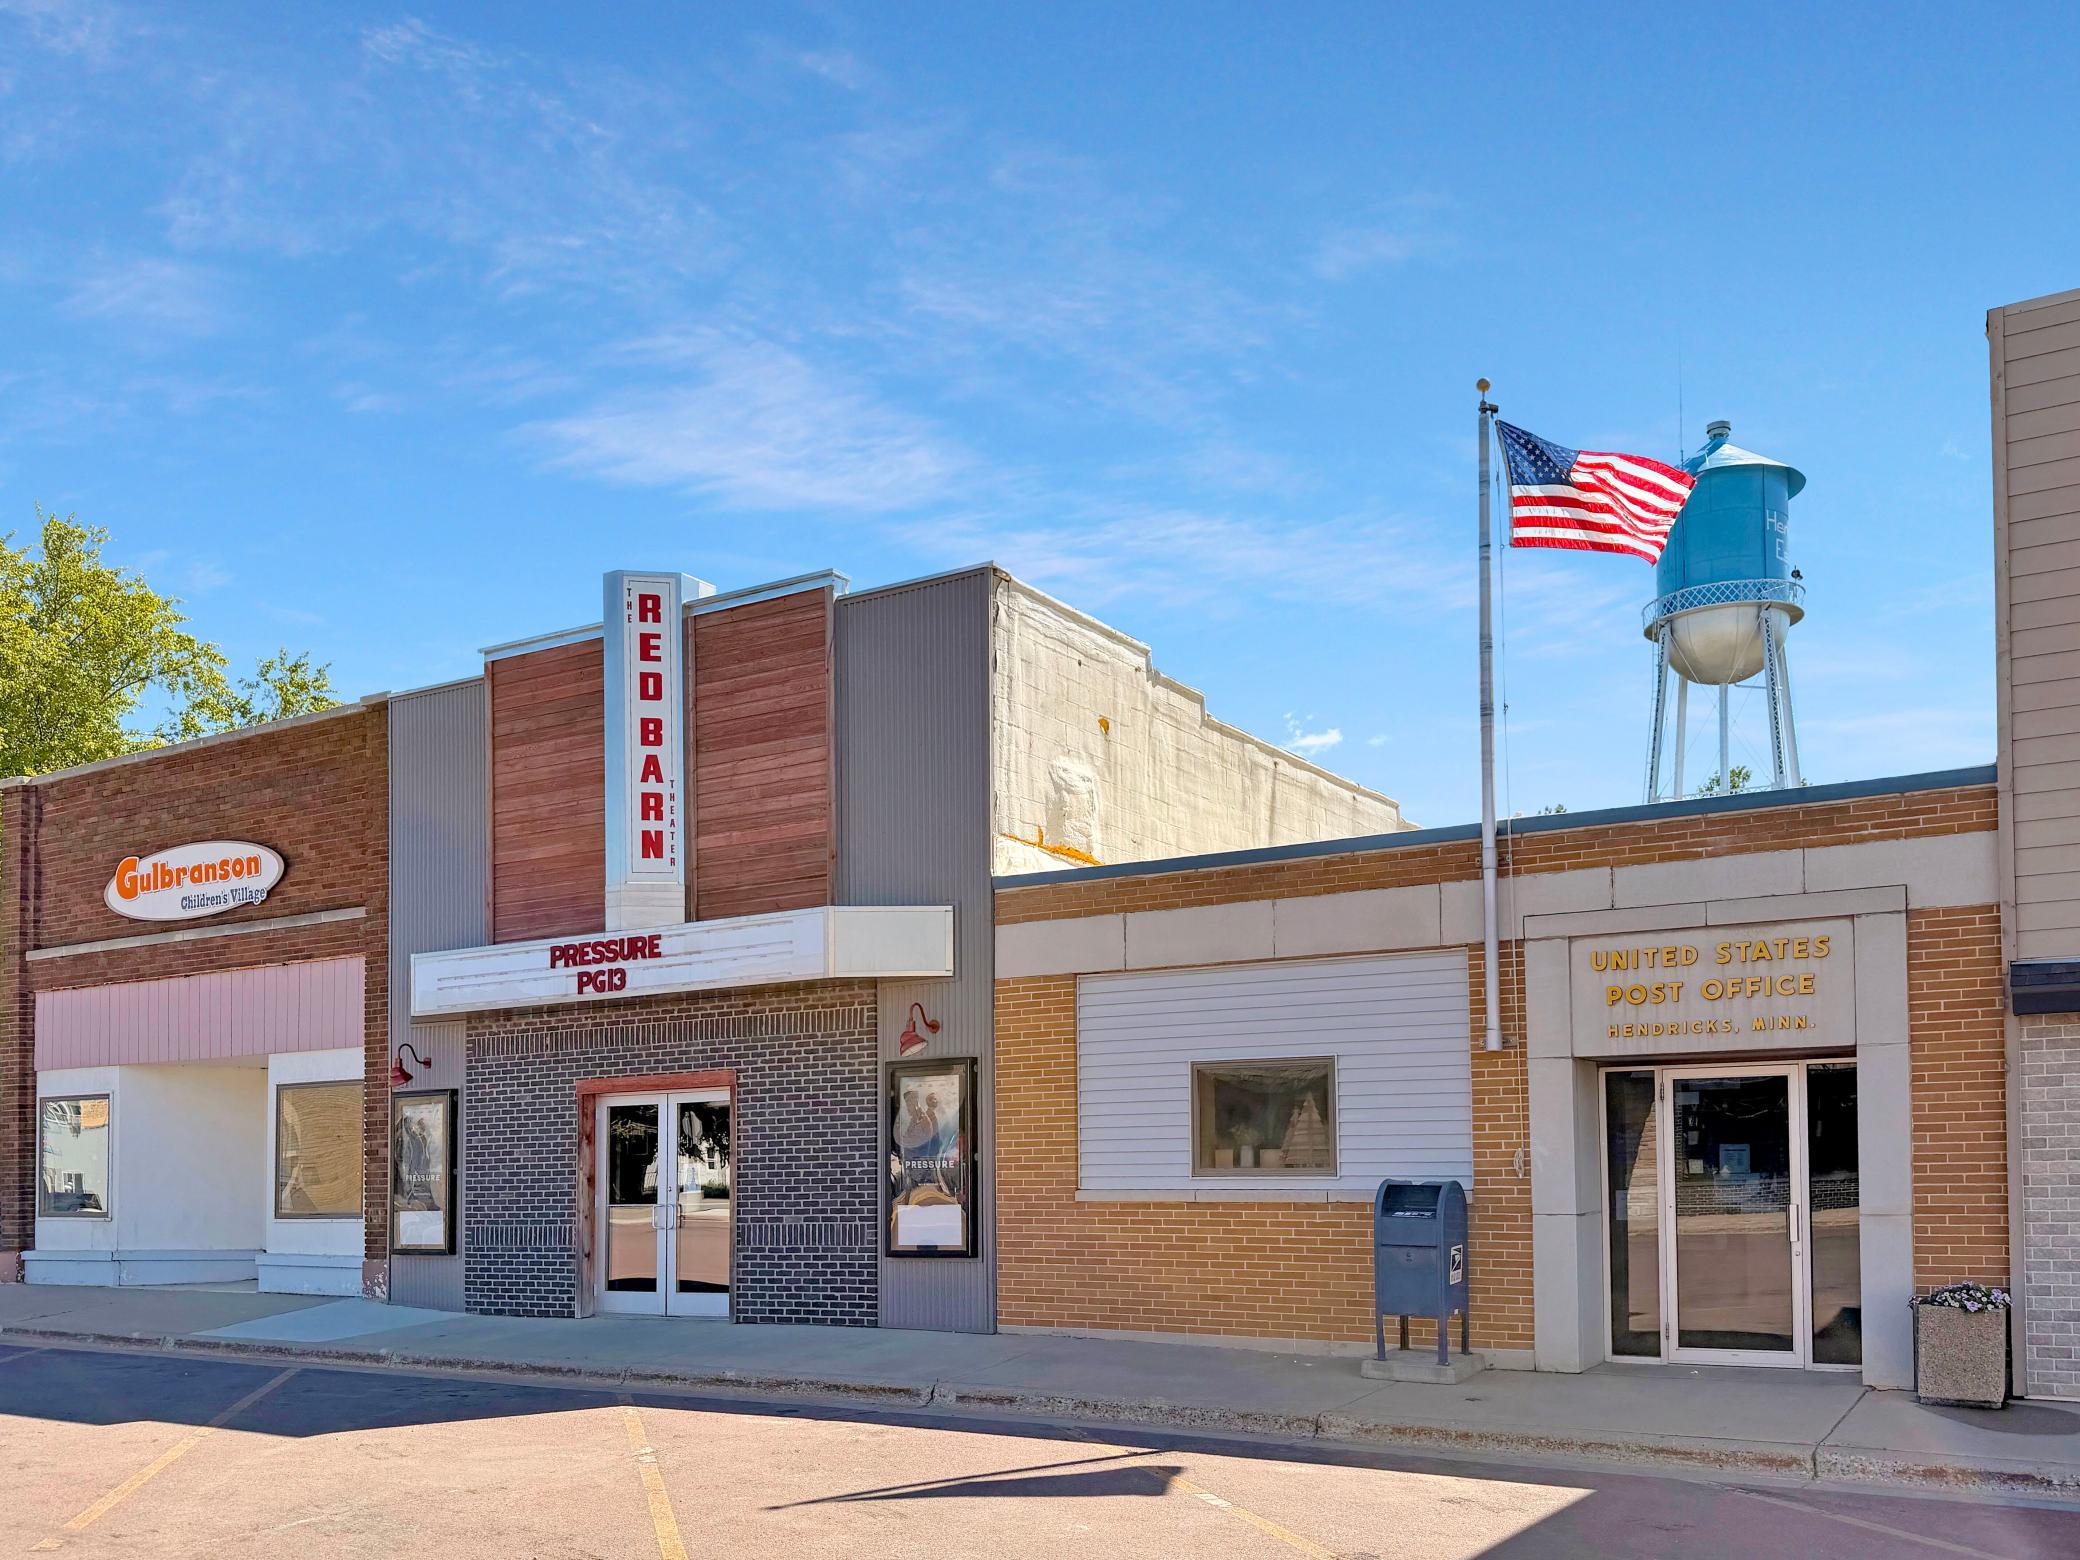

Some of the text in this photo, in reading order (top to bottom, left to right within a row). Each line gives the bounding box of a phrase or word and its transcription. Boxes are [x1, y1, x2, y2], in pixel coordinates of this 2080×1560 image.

[638, 593, 664, 859] RED BARN
[115, 855, 262, 900] Gulbranson
[181, 886, 267, 910] Children's Village
[549, 934, 662, 969] PRESSURE
[1590, 936, 1831, 972] UNITED STATES
[577, 967, 627, 995] PG13
[1606, 972, 1816, 1006] POST OFFICE
[1607, 1015, 1817, 1038] HENDRICKS, MINN.
[905, 1160, 955, 1170] PRESSURE
